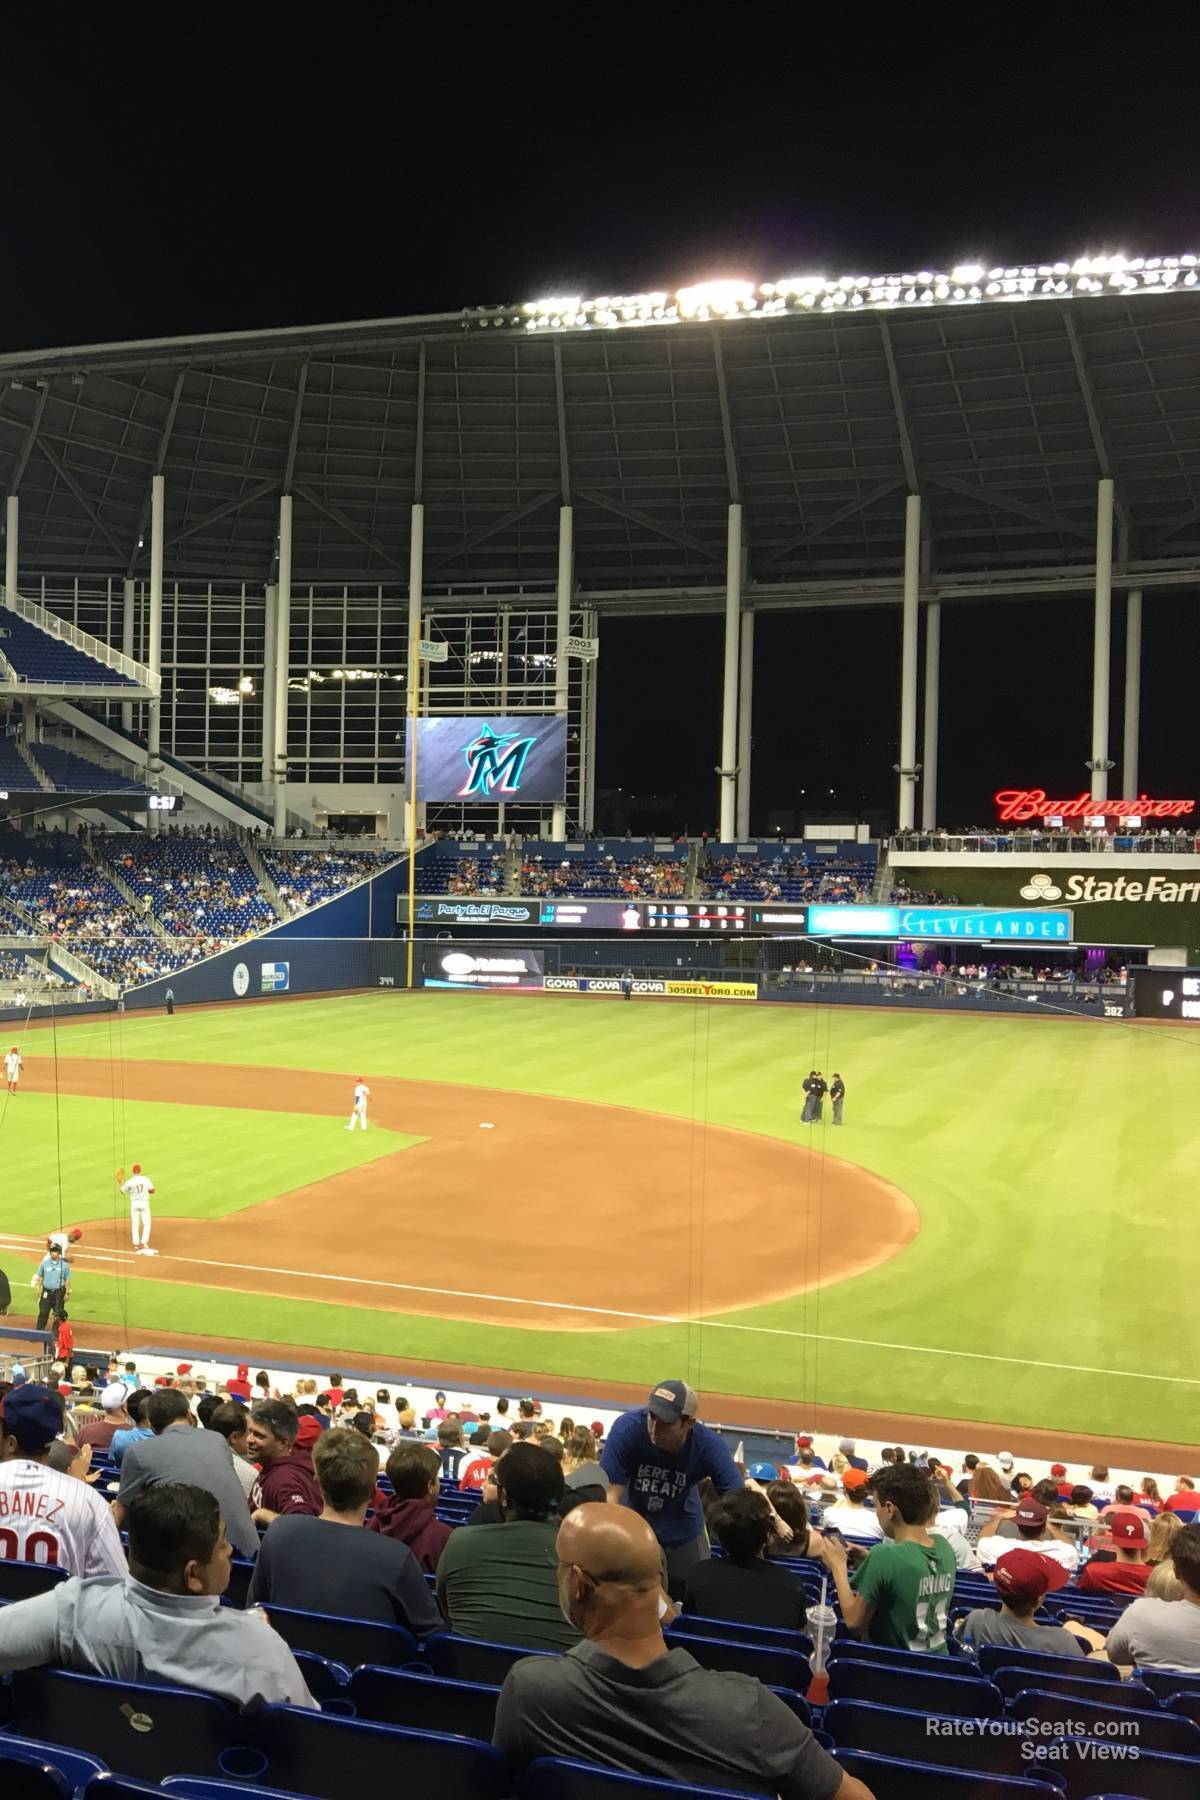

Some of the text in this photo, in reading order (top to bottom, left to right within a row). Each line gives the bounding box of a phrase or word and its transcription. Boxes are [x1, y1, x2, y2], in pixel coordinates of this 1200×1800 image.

[568, 638, 592, 648] 2003
[996, 790, 1196, 820] Budweiser
[1065, 875, 1143, 901] State
[438, 904, 467, 916] Party
[466, 904, 480, 915] En
[480, 904, 490, 915] El
[491, 904, 529, 918] Parque
[903, 912, 1066, 936] CLEVELANDER
[379, 976, 394, 986] 344
[546, 978, 578, 989] GOYA
[588, 980, 620, 991] GOYA
[631, 982, 664, 992] GOYA
[1104, 1006, 1124, 1017] 382
[638, 1464, 671, 1480] HERE
[919, 1572, 952, 1597] IRVING
